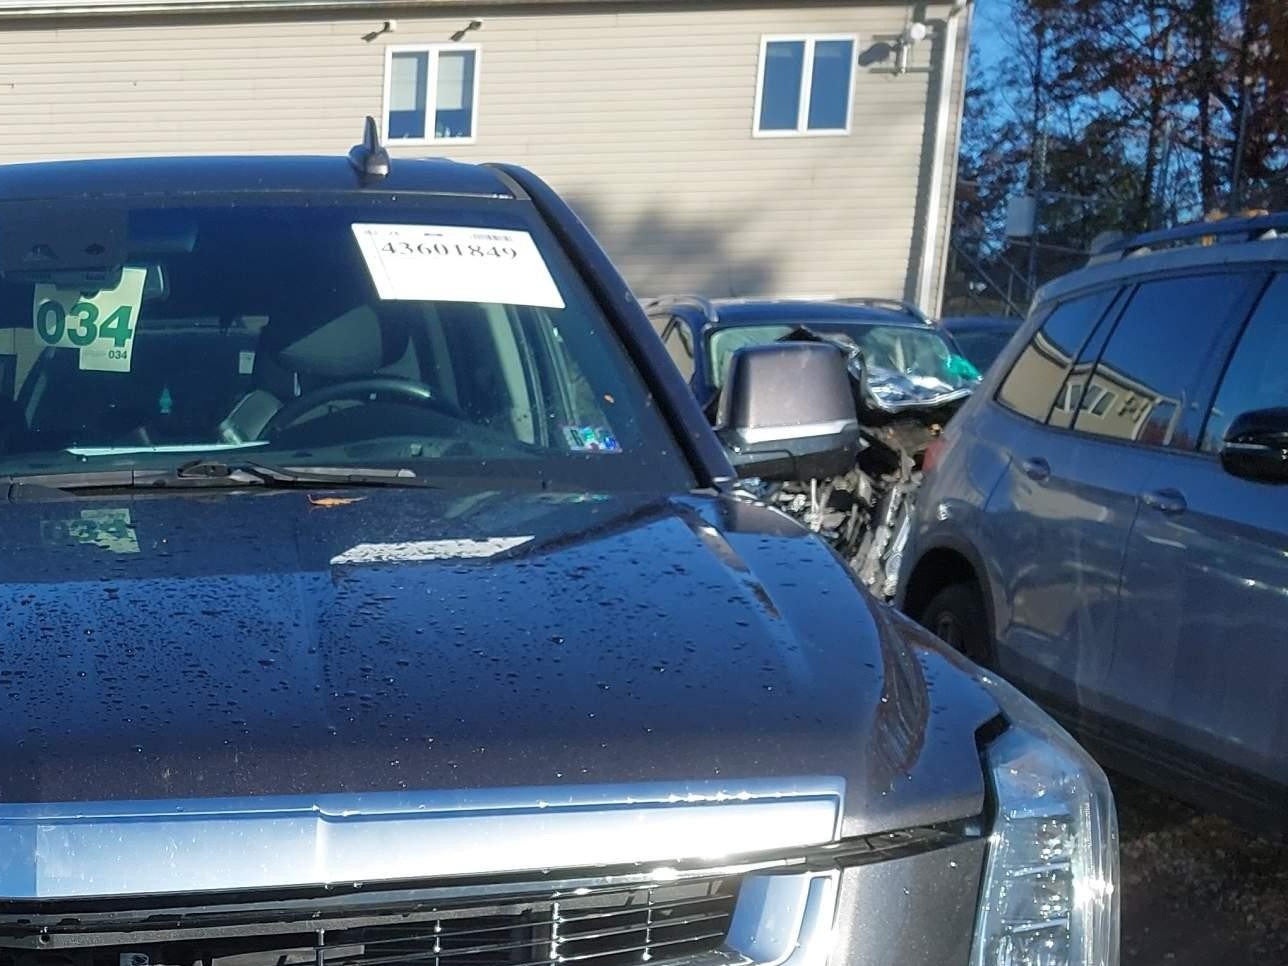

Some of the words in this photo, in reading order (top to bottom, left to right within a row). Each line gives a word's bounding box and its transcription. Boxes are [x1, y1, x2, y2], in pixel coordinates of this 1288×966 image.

[381, 241, 518, 259] 43601849
[36, 300, 133, 347] 034
[108, 350, 128, 360] 034
